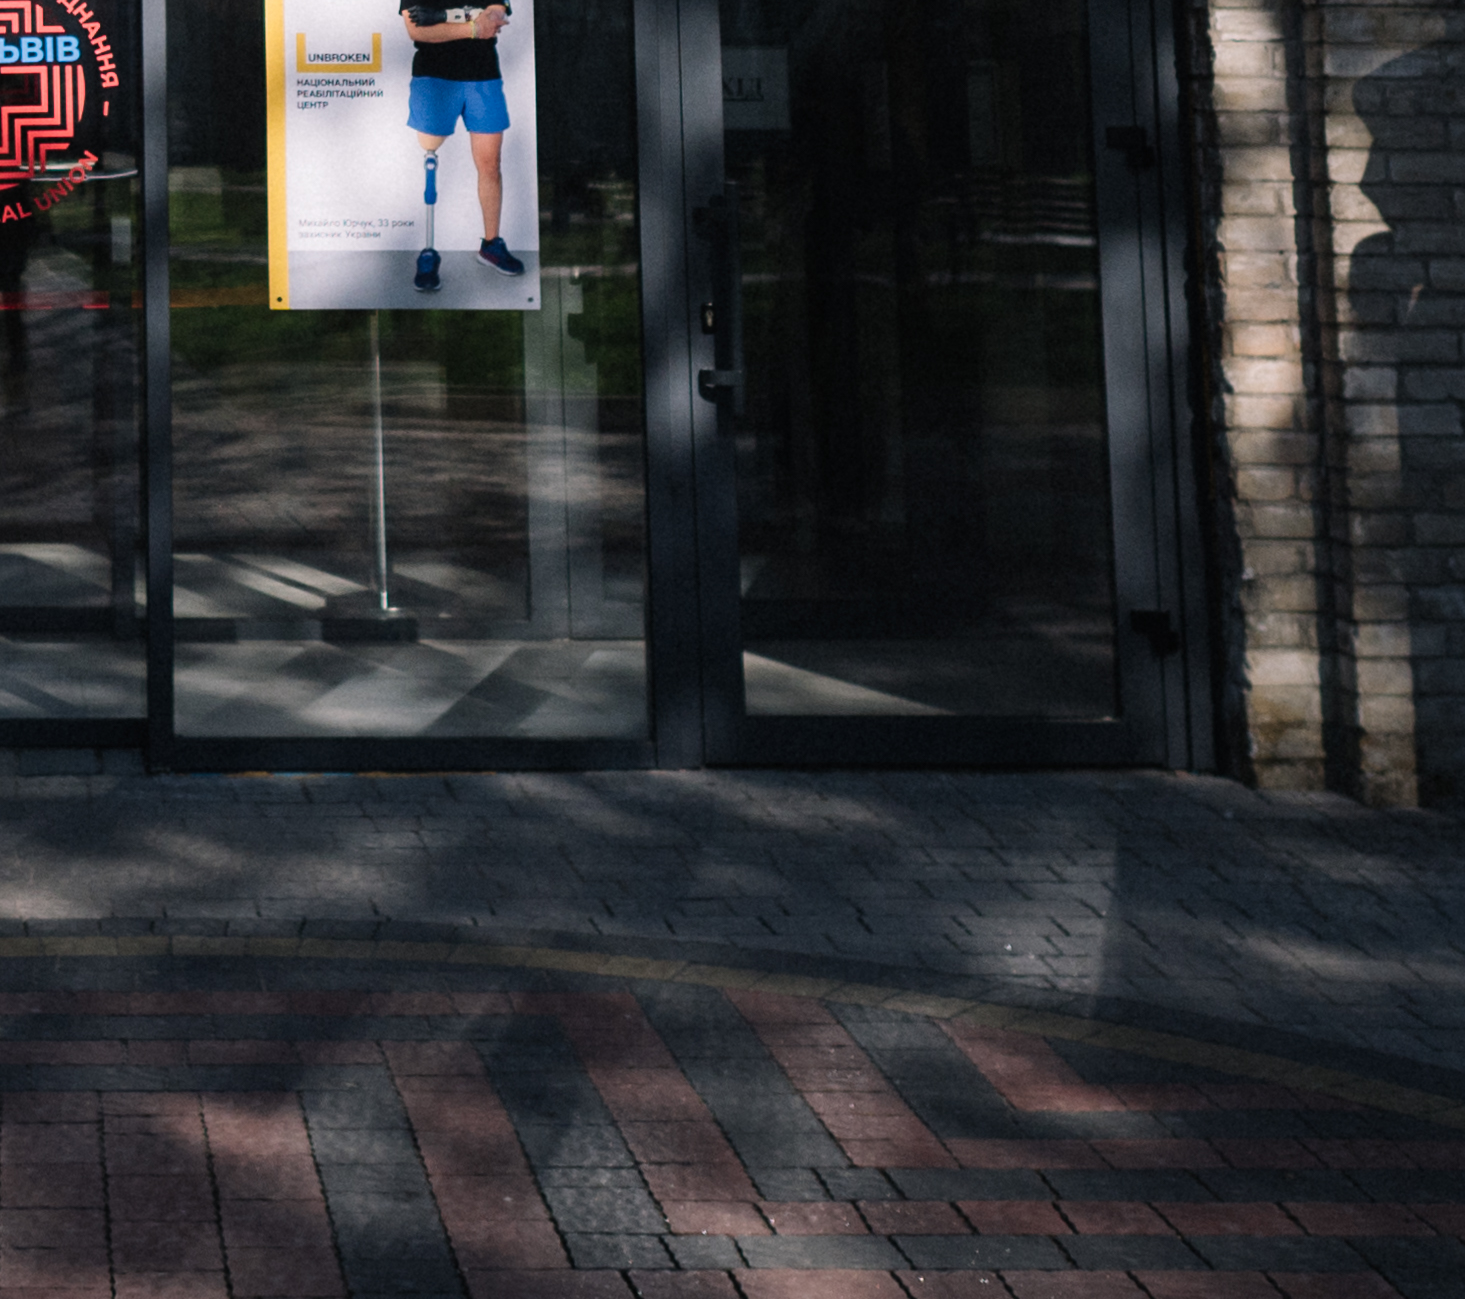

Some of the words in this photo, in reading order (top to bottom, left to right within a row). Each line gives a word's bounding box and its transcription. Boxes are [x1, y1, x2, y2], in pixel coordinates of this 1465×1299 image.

[307, 52, 371, 63] UNBROKEN
[296, 77, 376, 88] НАЦІОНАЛЬНИЙ
[296, 88, 384, 99] РЕАБІЛІТАЦІЙНИЙ
[296, 100, 329, 110] ЦЕНТР
[33, 150, 99, 211] UNION
[378, 218, 389, 227] 33
[391, 219, 415, 229] роки
